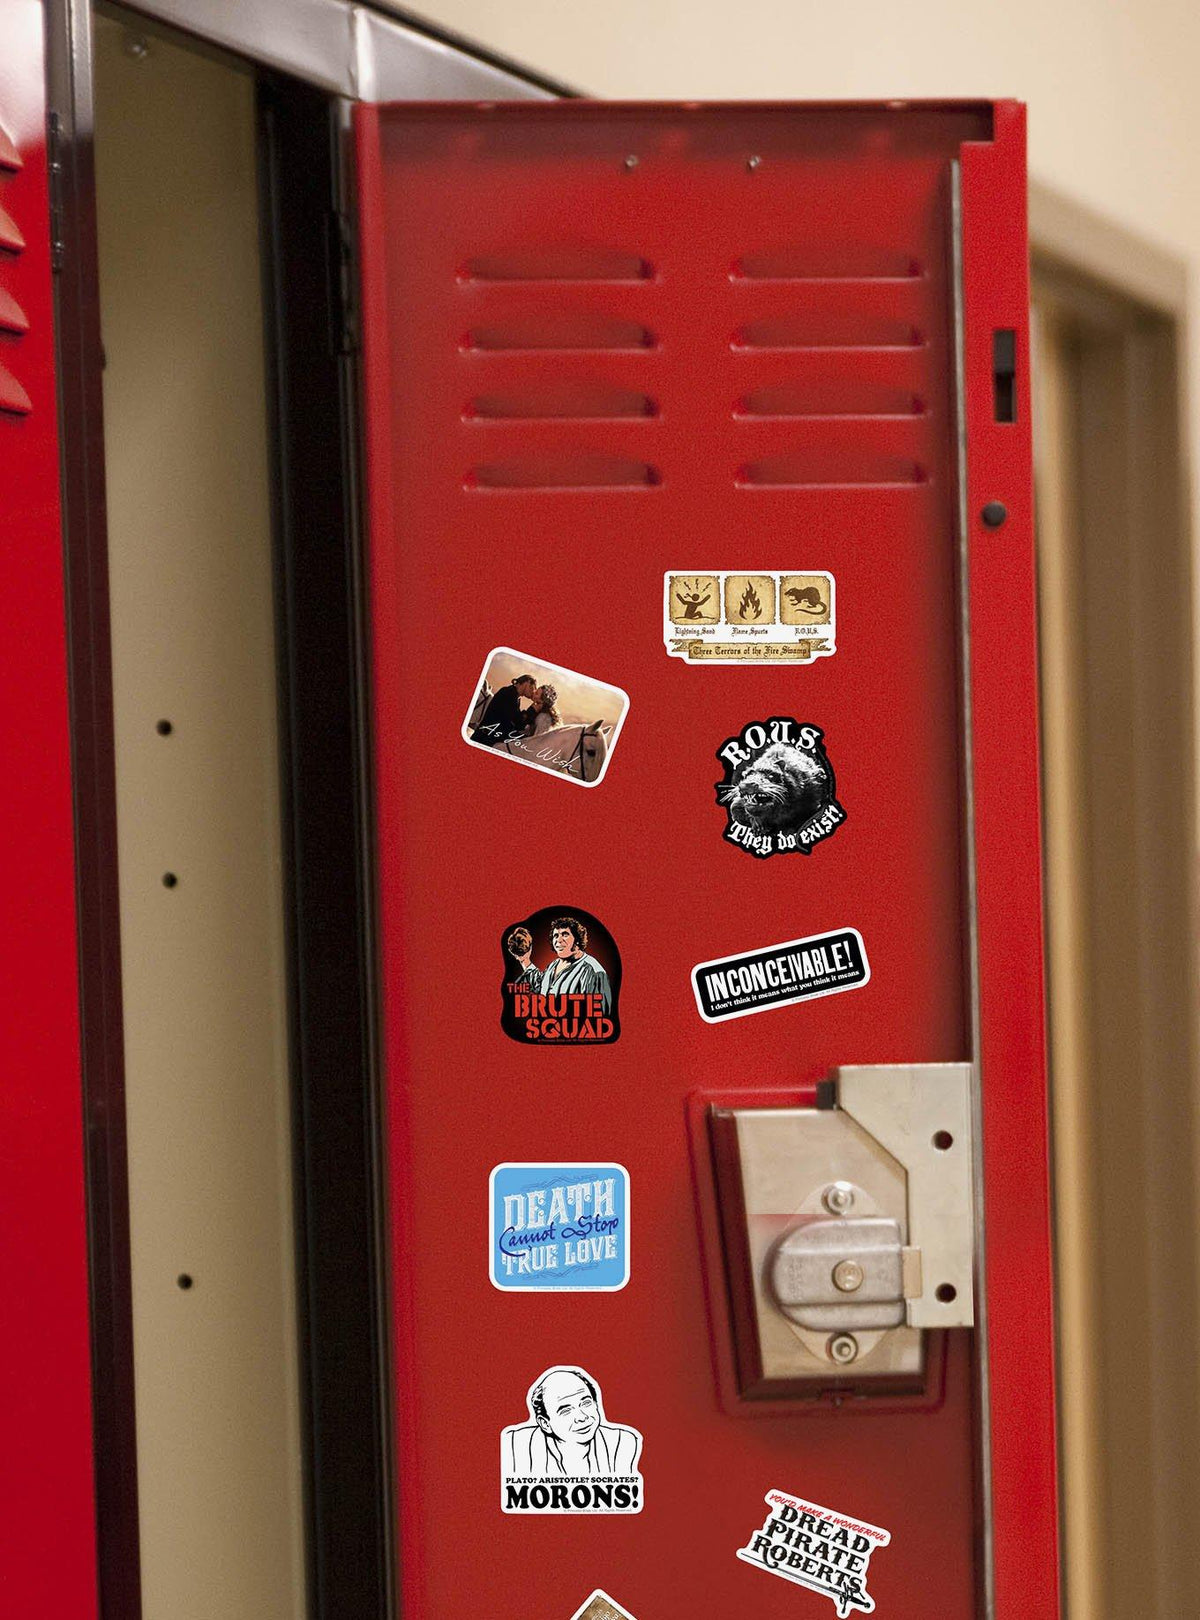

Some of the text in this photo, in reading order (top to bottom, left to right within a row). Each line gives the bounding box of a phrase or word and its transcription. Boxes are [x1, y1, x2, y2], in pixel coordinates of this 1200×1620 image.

[675, 627, 700, 637] Lightning
[693, 646, 807, 657] Three Terrors of the Fire Swamp
[732, 627, 769, 637] Flame Spurts
[479, 722, 503, 738] As
[504, 730, 534, 753] You
[536, 748, 580, 773] Wish
[720, 721, 821, 770] R.O.U.S.
[727, 821, 773, 855] They
[777, 831, 797, 850] do
[507, 983, 530, 994] THE
[704, 940, 854, 1003] INCONCEIVABLE!
[710, 1004, 715, 1012] I
[715, 1000, 733, 1011] don't
[733, 996, 751, 1006] think
[751, 993, 757, 1002] it
[758, 990, 780, 1000] means
[780, 985, 799, 995] what
[799, 981, 813, 991] you
[813, 977, 831, 988] think
[831, 974, 837, 982] it
[837, 970, 860, 979] means
[514, 994, 603, 1018] BRUTE
[525, 1018, 614, 1039] SQUAD
[503, 1178, 615, 1233] DEATH
[499, 1213, 619, 1257] Cannot Stop
[502, 1235, 618, 1276] TRUE LOVE
[505, 1484, 639, 1509] MORONS!
[769, 1493, 797, 1508] YOU'D
[797, 1504, 824, 1518] MAKE
[833, 1517, 887, 1542] WONDERFUL
[765, 1518, 865, 1575] PIRATE
[779, 1504, 870, 1554] DREAD
[751, 1534, 863, 1594] ROBERTS
